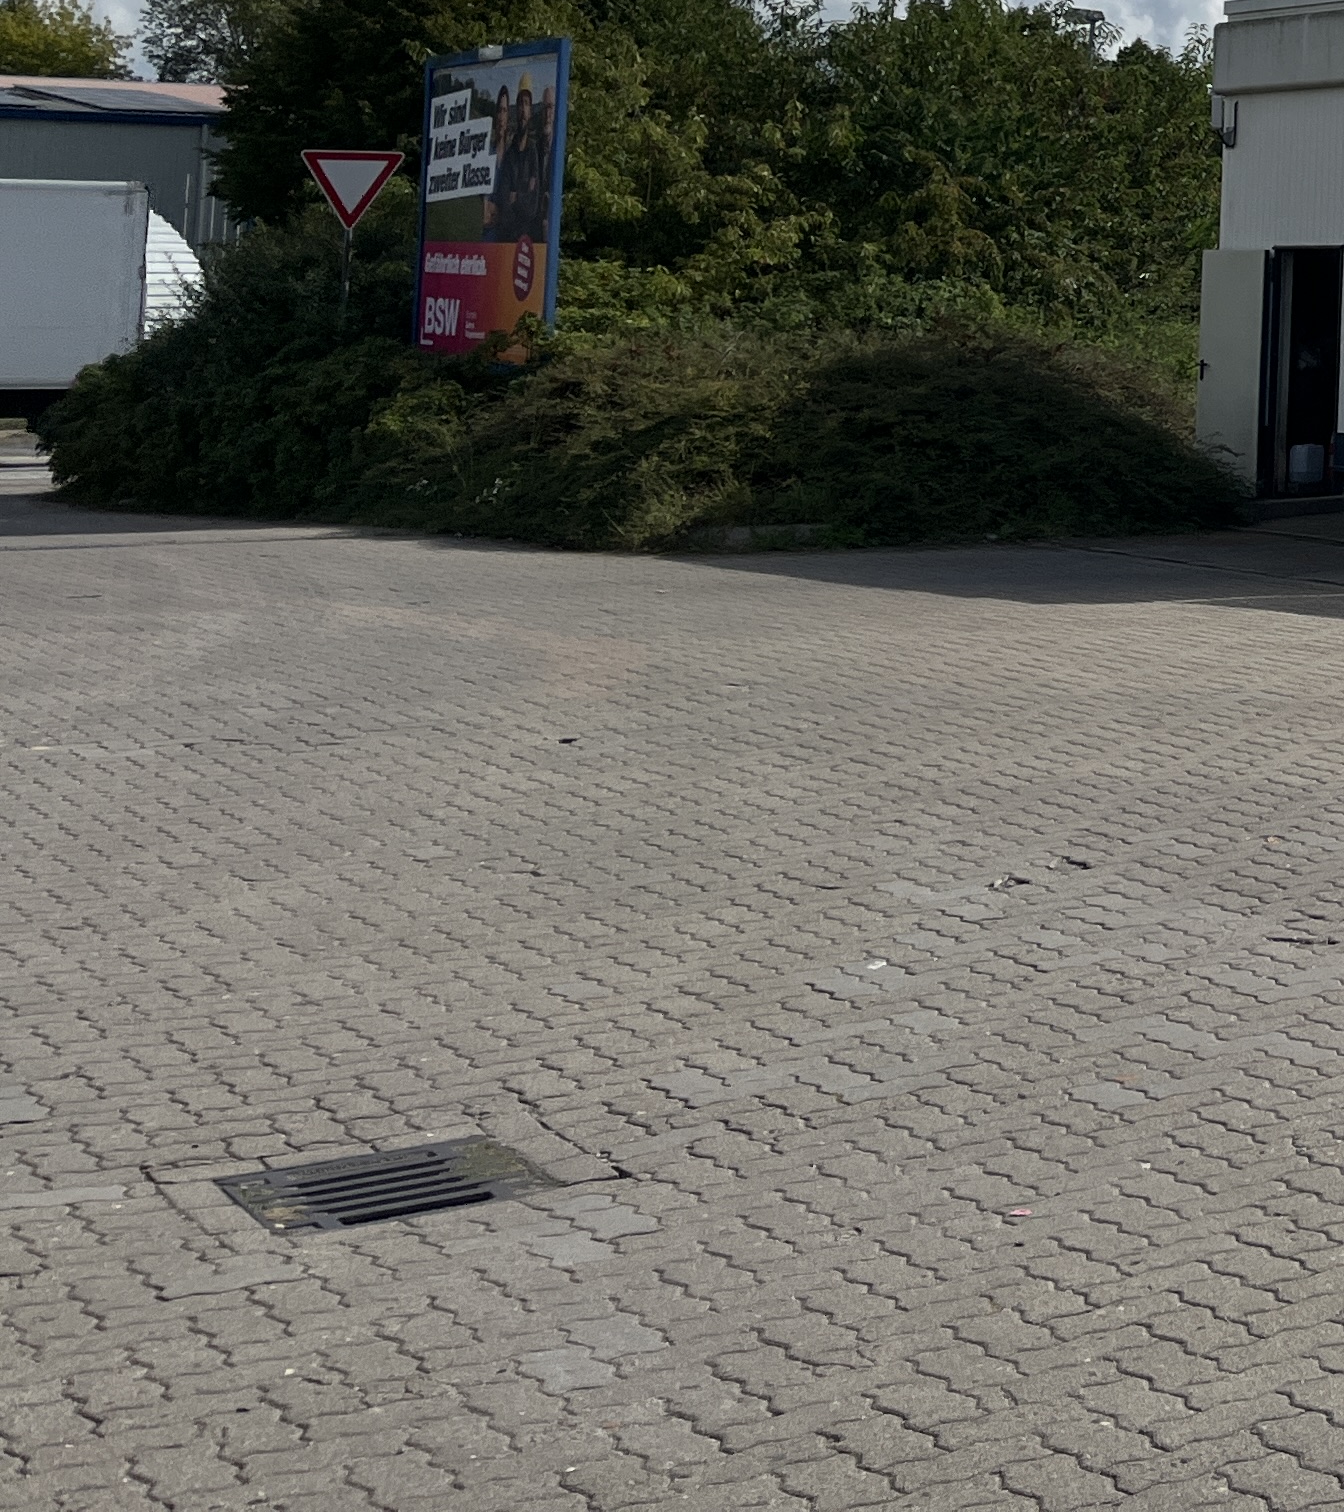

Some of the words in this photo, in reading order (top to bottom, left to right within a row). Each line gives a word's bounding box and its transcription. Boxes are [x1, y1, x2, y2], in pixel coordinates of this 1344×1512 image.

[434, 103, 447, 129] Wir
[448, 97, 468, 125] sind
[434, 134, 456, 160] keine
[458, 128, 488, 159] Bürger
[428, 167, 460, 194] zweiter
[461, 163, 491, 188] Klasse.
[424, 296, 460, 336] BSW
